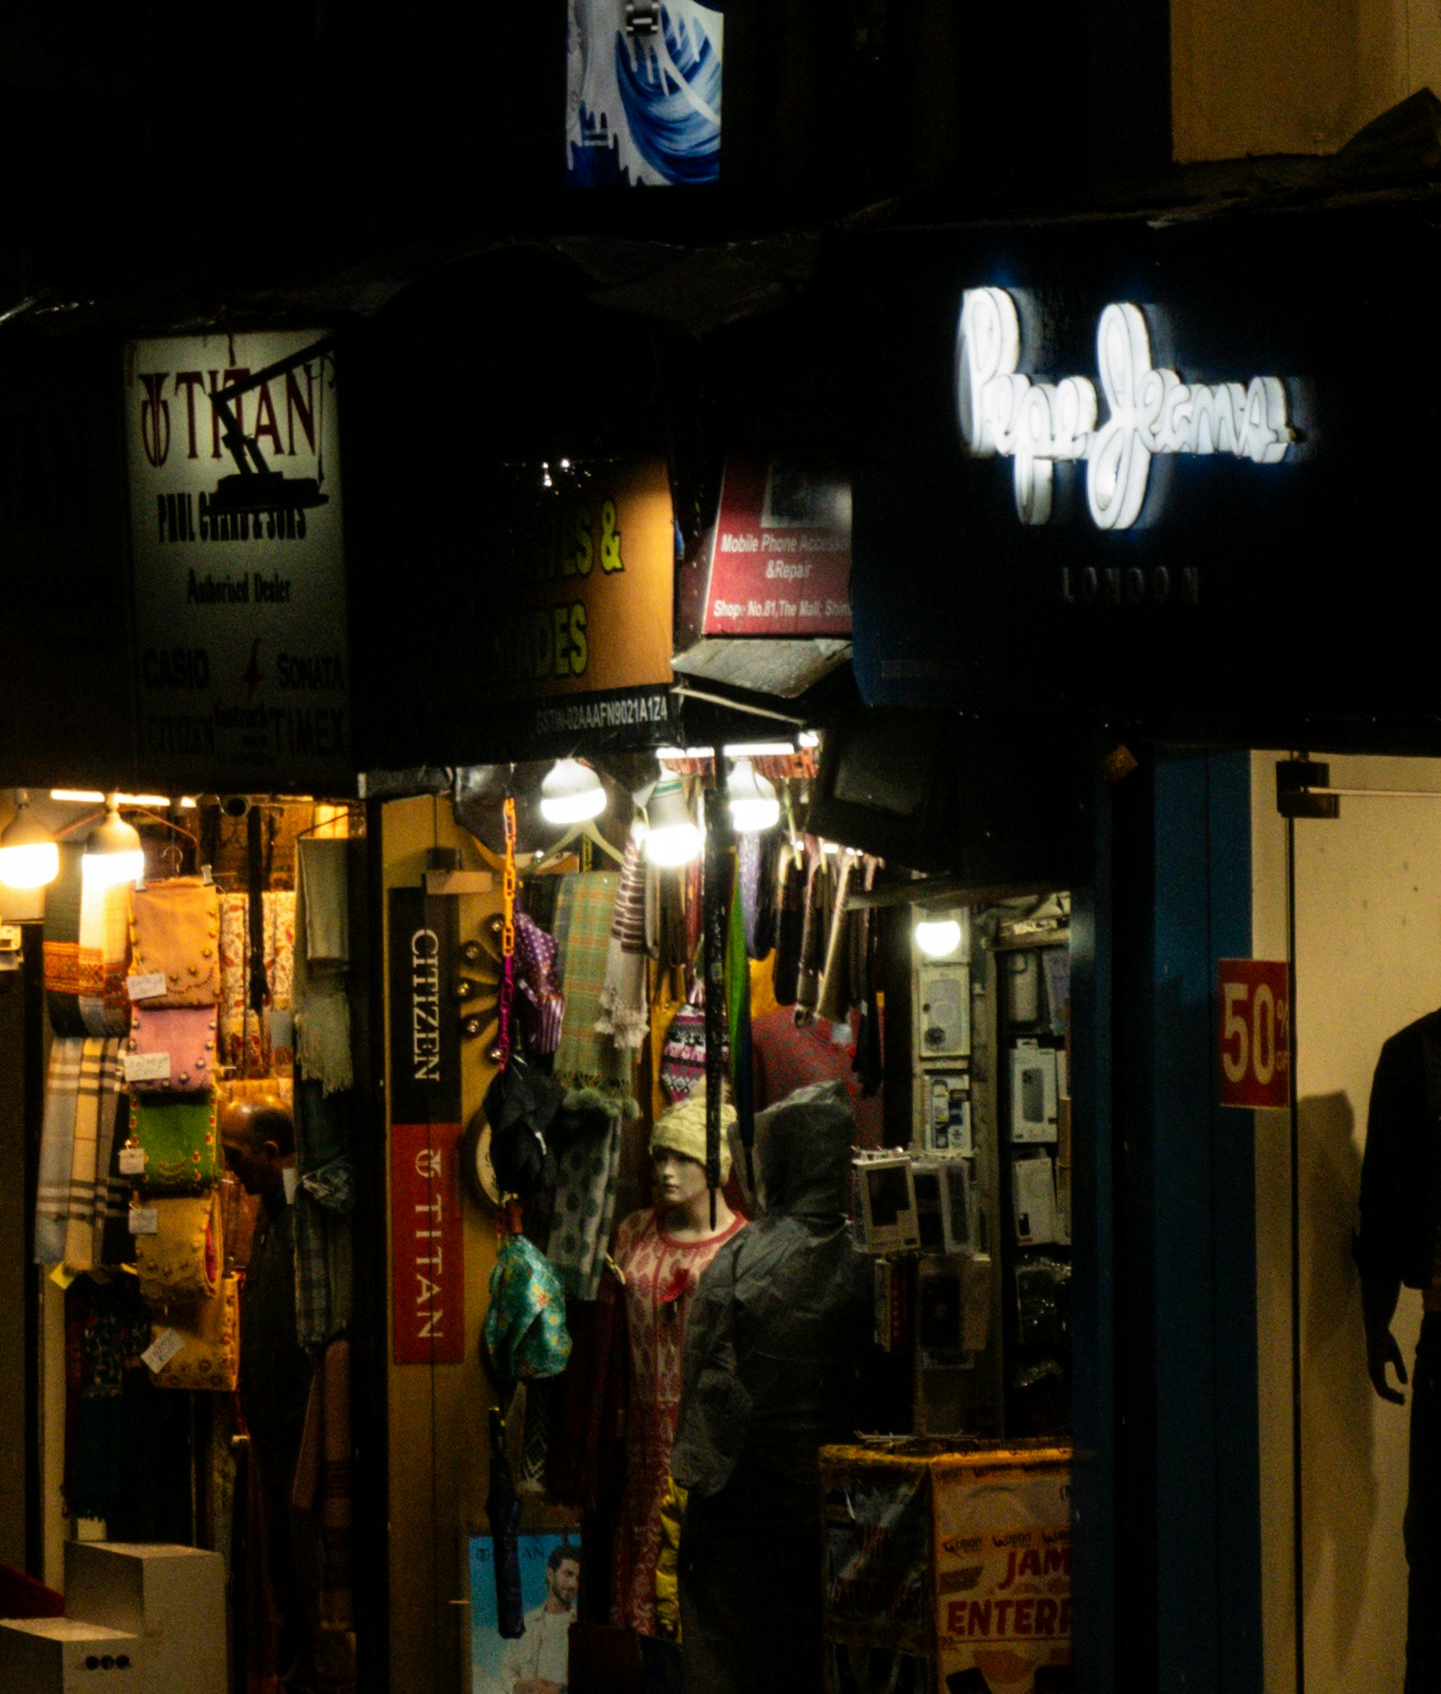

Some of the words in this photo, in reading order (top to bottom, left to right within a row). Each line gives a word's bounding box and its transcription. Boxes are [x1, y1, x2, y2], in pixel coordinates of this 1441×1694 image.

[174, 363, 318, 460] TITAN
[960, 285, 1098, 526] Pepe
[1085, 302, 1288, 531] Jeans
[721, 533, 759, 553] Mobile
[761, 533, 798, 552] Phone
[1061, 566, 1199, 607] LONDON
[143, 648, 210, 690] CASIO
[277, 652, 346, 691] SONATA
[409, 927, 440, 1083] CITIZEN
[415, 1194, 444, 1340] TITAN
